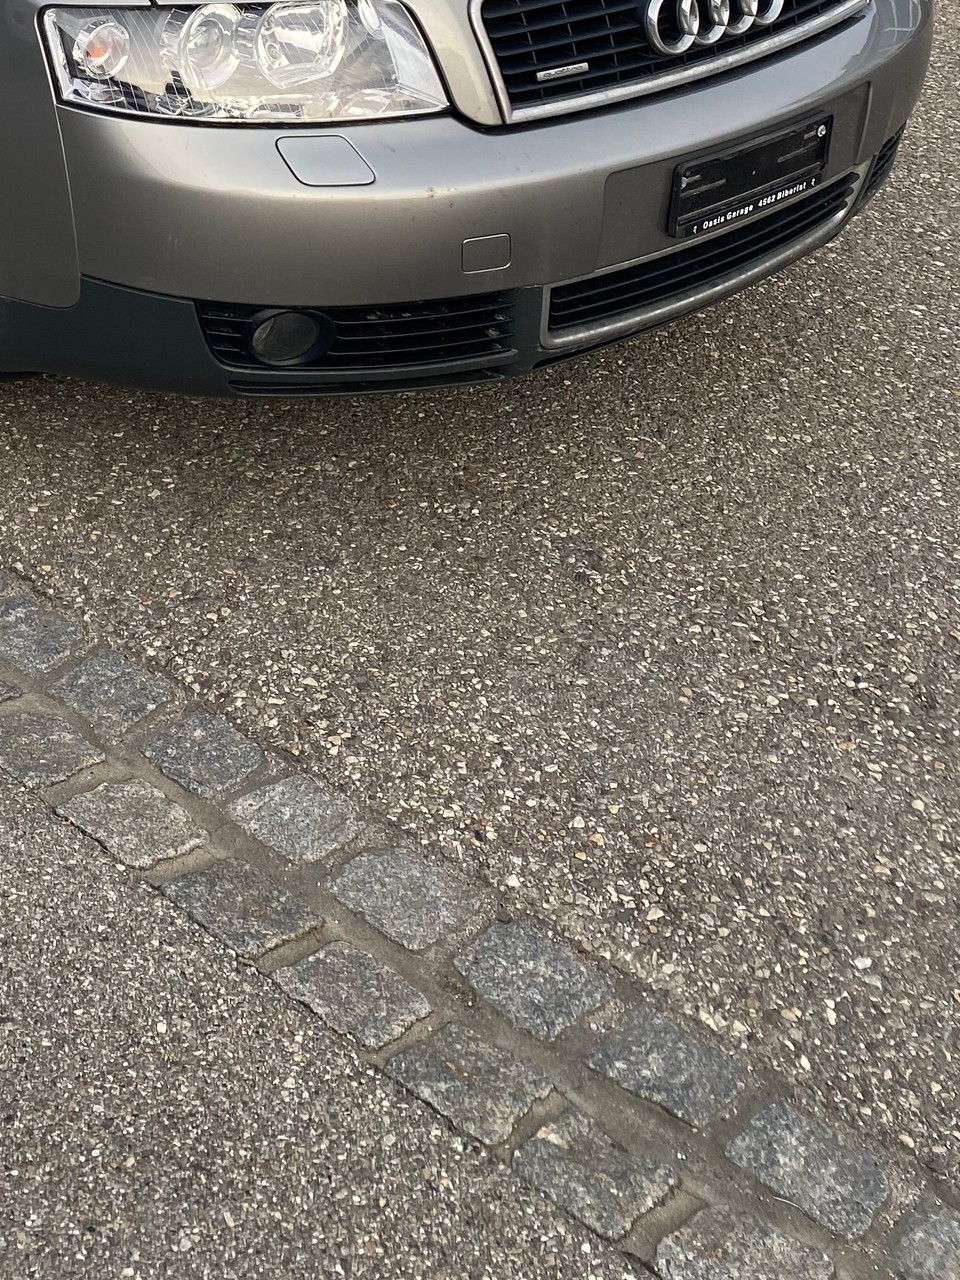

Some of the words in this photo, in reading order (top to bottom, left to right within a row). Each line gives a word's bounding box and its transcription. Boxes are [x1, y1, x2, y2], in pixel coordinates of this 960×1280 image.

[543, 65, 584, 79] quattro
[702, 216, 725, 230] Oasis
[726, 204, 754, 220] Garage
[757, 197, 776, 207] 4562
[776, 181, 807, 200] Biberist
